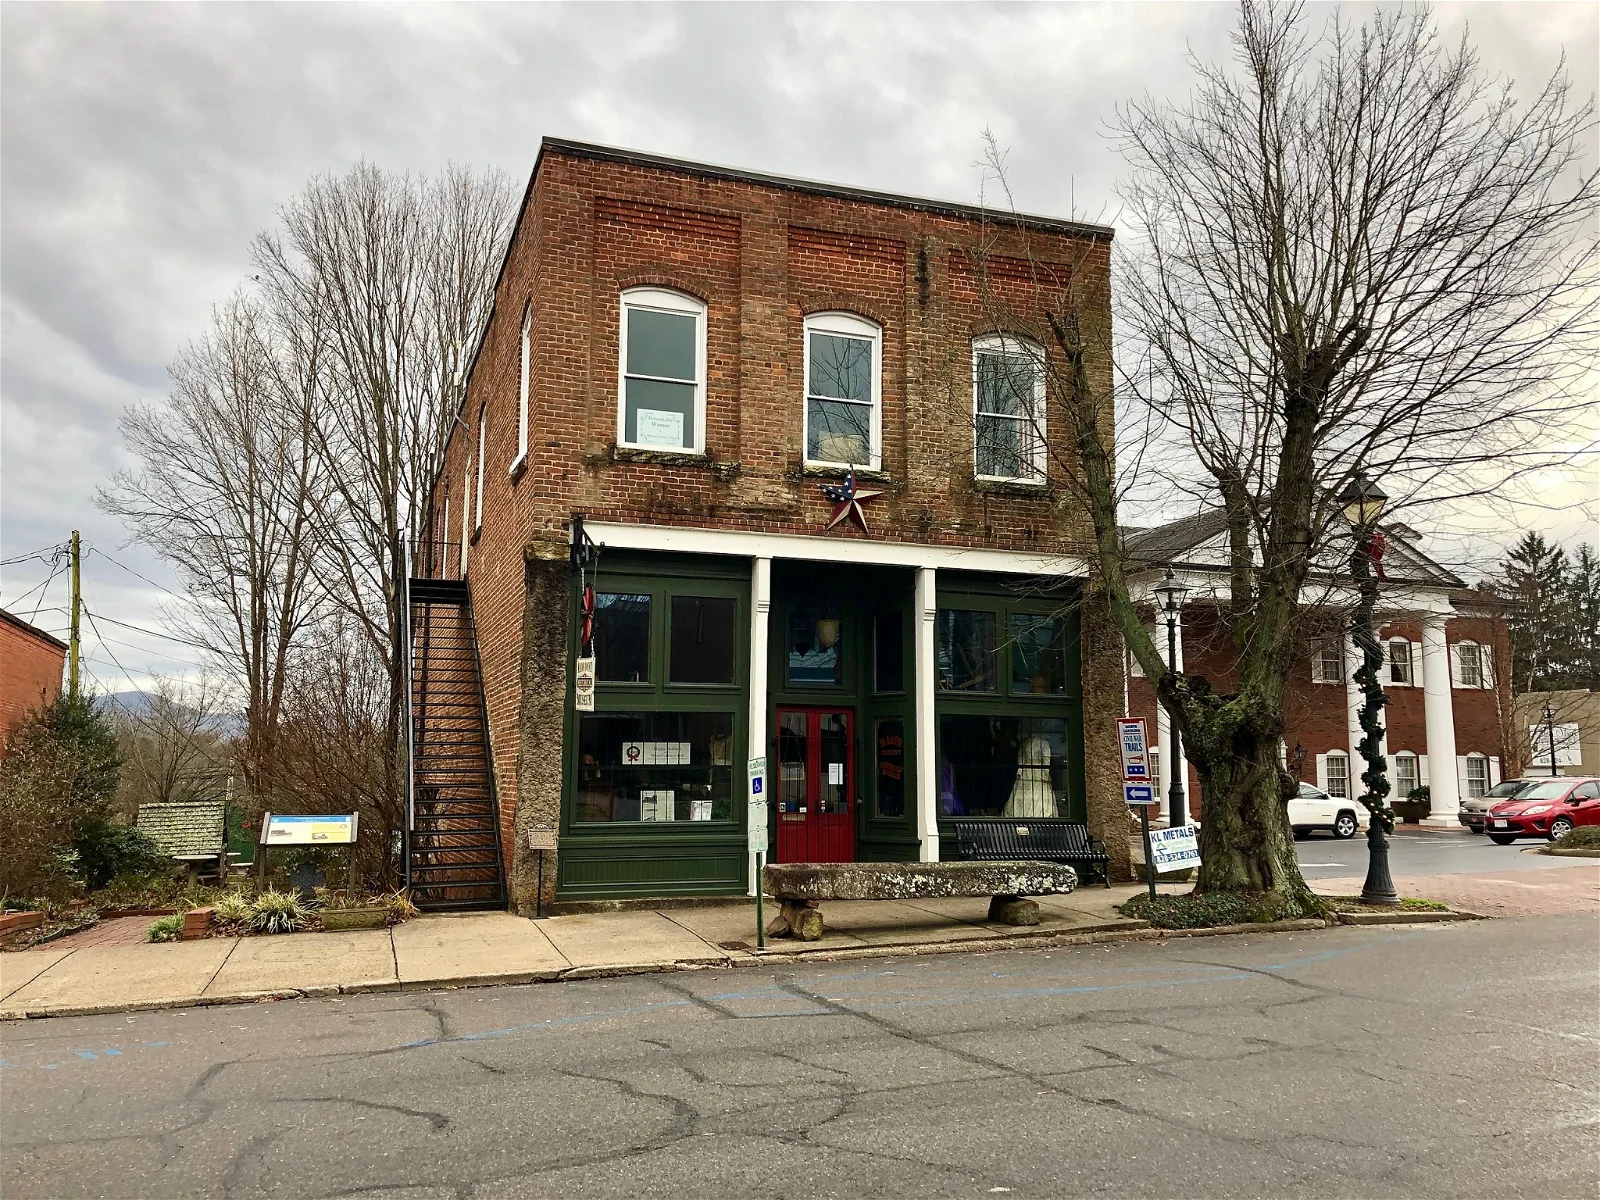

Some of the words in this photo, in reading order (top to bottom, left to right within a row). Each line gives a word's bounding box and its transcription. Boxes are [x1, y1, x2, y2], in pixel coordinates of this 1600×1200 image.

[879, 735, 904, 748] MACON
[1124, 743, 1143, 752] TRAILS
[1151, 832, 1162, 843] KL
[1162, 827, 1194, 841] METALS
[1156, 850, 1198, 863] 828-524-0761
